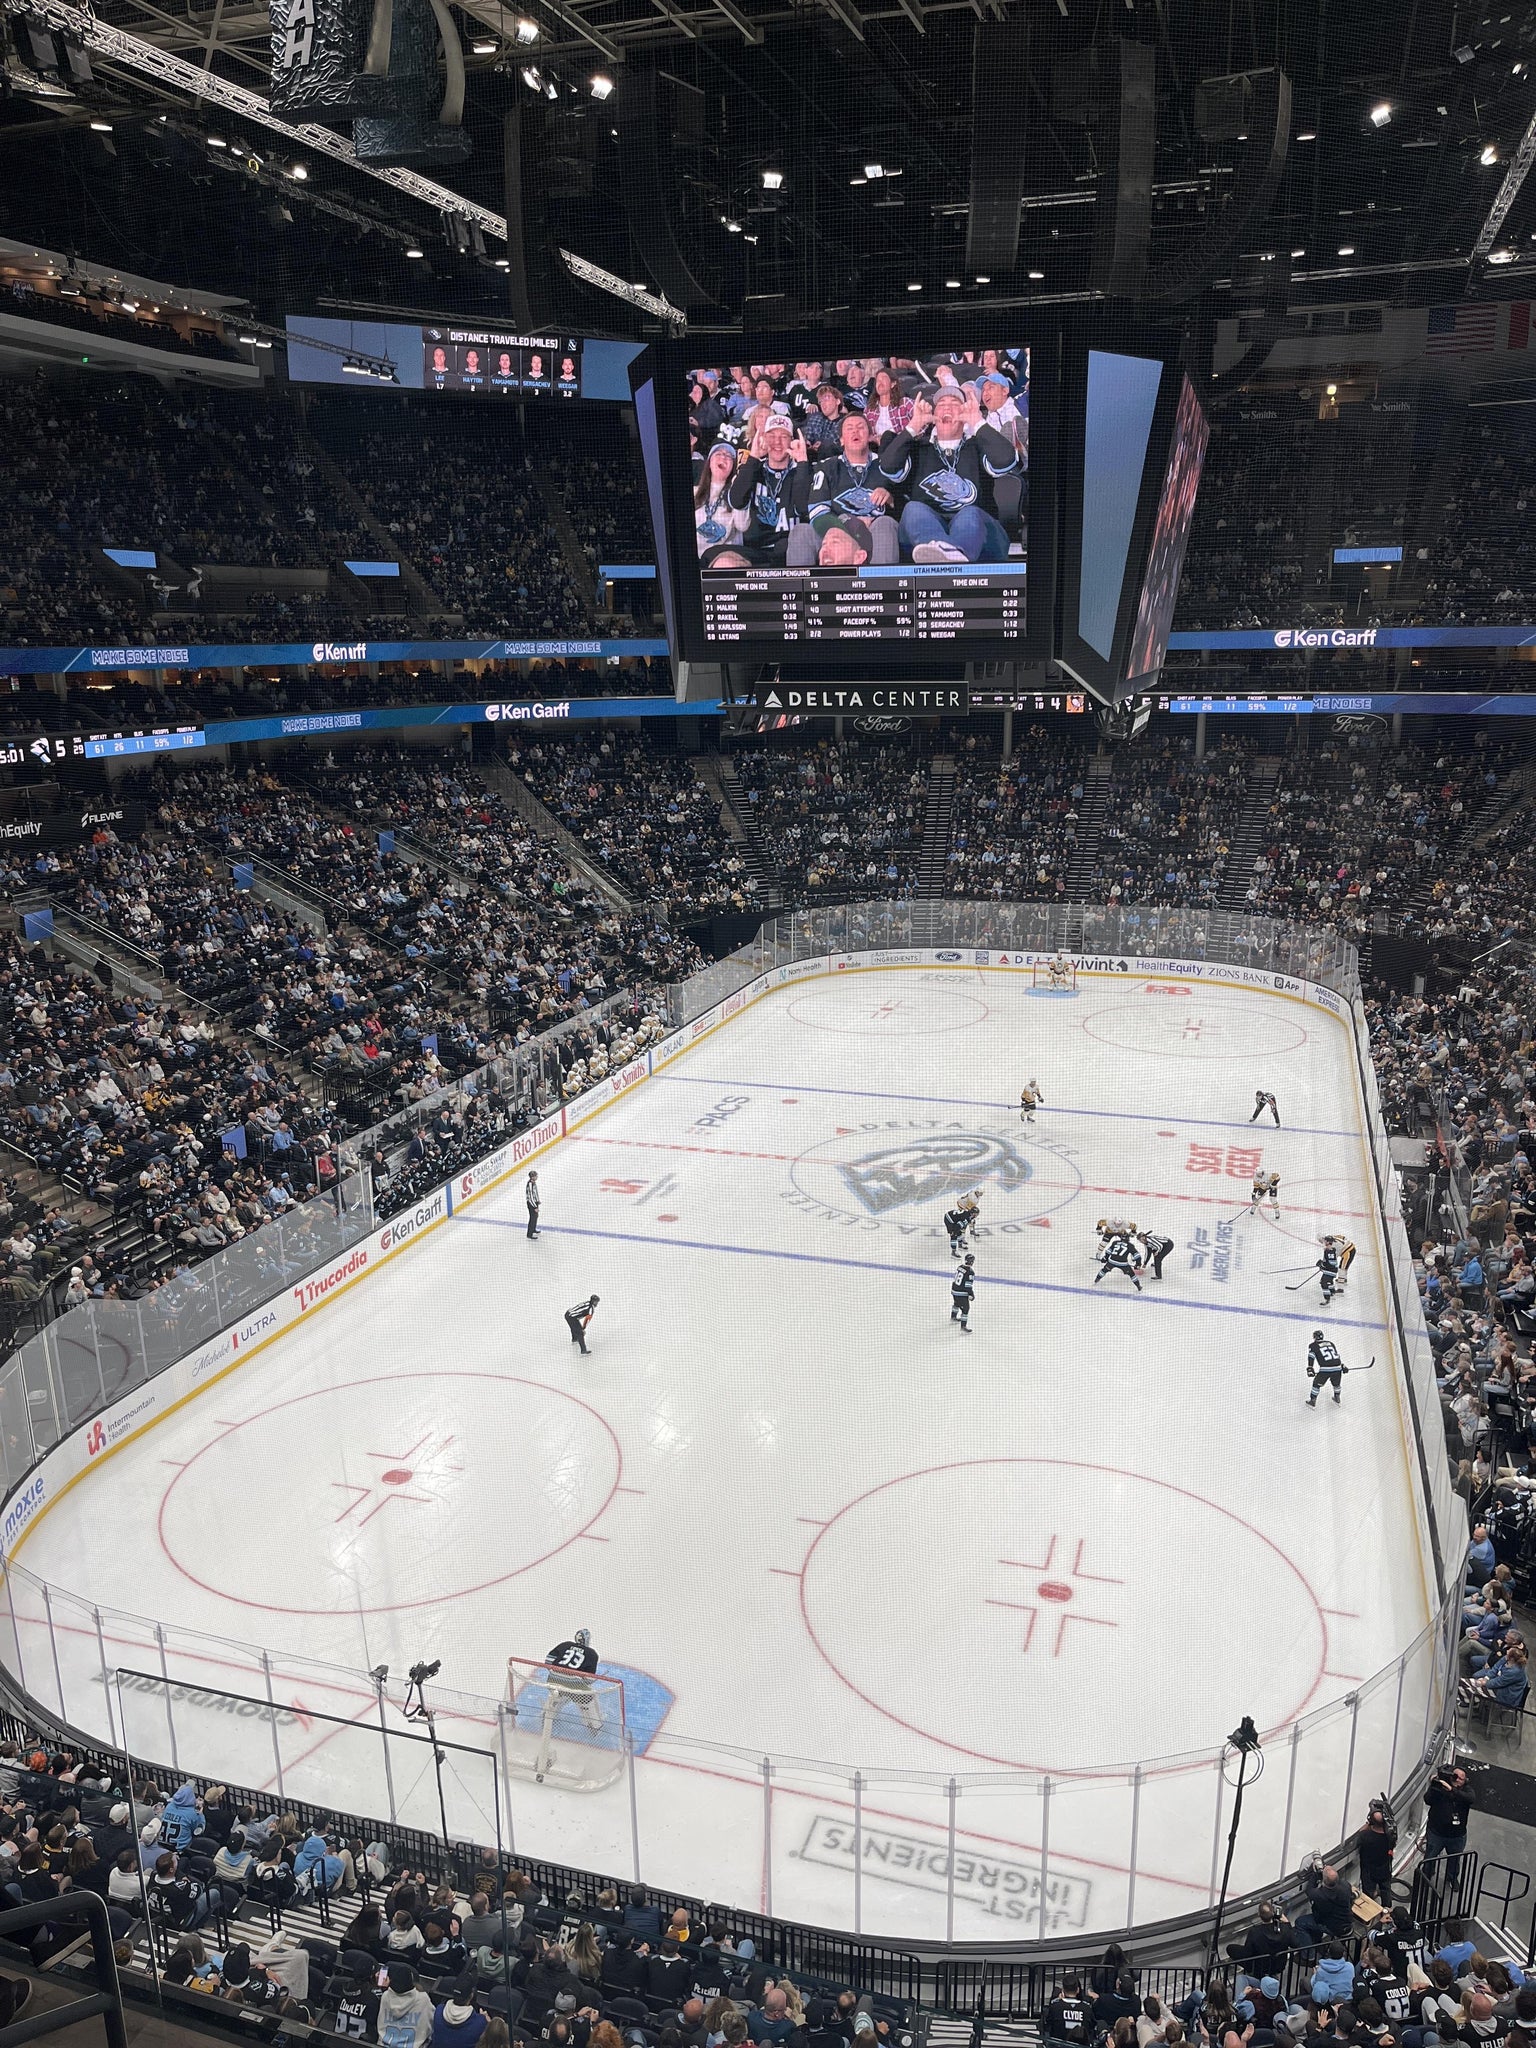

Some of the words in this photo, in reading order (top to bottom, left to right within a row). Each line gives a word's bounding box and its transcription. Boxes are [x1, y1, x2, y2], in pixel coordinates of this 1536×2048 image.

[450, 332, 488, 344] DISTANCE
[489, 334, 529, 347] TRAVELED
[530, 336, 558, 350] (MILES)
[563, 390, 573, 398] 3.2
[1251, 410, 1278, 420] Smith's
[1293, 630, 1327, 646] Ken
[1330, 629, 1377, 646] Garff
[325, 643, 347, 660] Ken
[505, 642, 535, 654] MAKE
[536, 641, 567, 654] SOME
[568, 641, 601, 653] NOISE
[92, 649, 125, 665] MAKE
[126, 649, 156, 664] SOME
[158, 648, 189, 663] NOISE
[789, 691, 863, 707] DELTA
[873, 691, 960, 707] CENTER
[1051, 697, 1060, 710] 4
[1158, 702, 1169, 710] 29
[1248, 703, 1266, 711] 59%
[1331, 698, 1372, 710] NOISE
[501, 704, 531, 720] Ken
[532, 702, 570, 719] Garff
[282, 719, 307, 733] MAKE
[307, 717, 333, 731] SOME
[334, 714, 361, 728] NOISE
[1332, 714, 1376, 734] Ford
[56, 740, 66, 757] 5
[94, 744, 104, 754] 61
[114, 742, 124, 752] 26
[136, 740, 144, 750] 11
[154, 738, 170, 748] 59%
[183, 736, 193, 745] 1/2
[73, 745, 84, 755] 29
[89, 810, 123, 823] FILEVINE
[803, 962, 822, 972] Health
[1072, 956, 1114, 972] vivint
[1137, 960, 1203, 975] HealthEquity
[1208, 967, 1240, 980] ZIONS
[1243, 972, 1270, 985] BANK
[1319, 995, 1340, 1013] EXPRESS
[622, 1062, 646, 1088] Smith's
[694, 1096, 750, 1127] PACS
[513, 1140, 531, 1163] Rio
[531, 1121, 558, 1149] Tinto
[860, 1120, 964, 1131] DELTA
[979, 1124, 1080, 1156] CENTER
[1185, 1143, 1225, 1174] SEAT
[1225, 1146, 1264, 1178] GEEK
[779, 1190, 881, 1232] CENTER
[391, 1218, 414, 1245] Ken
[415, 1196, 443, 1227] Garff
[1216, 1220, 1233, 1244] FIRST
[1112, 1243, 1127, 1257] 27
[1211, 1246, 1231, 1285] AMERICA
[305, 1250, 367, 1302] Trucordia
[241, 1311, 277, 1342] ULTRA
[1320, 1347, 1341, 1362] 52
[108, 1396, 156, 1432] Intermountain
[109, 1423, 131, 1441] Health
[6, 1477, 44, 1537] moxie
[20, 1493, 46, 1526] CONTROL
[559, 1649, 585, 1669] 33
[822, 1828, 1072, 1907] INGREDIENTS
[982, 1895, 1068, 1930] JUST
[1406, 1949, 1424, 1968] 11
[693, 1982, 721, 1997] PETERKA
[1385, 1986, 1408, 1999] COOLEY
[340, 1998, 366, 2016] COOLEY
[1063, 2009, 1083, 2022] CLYDE
